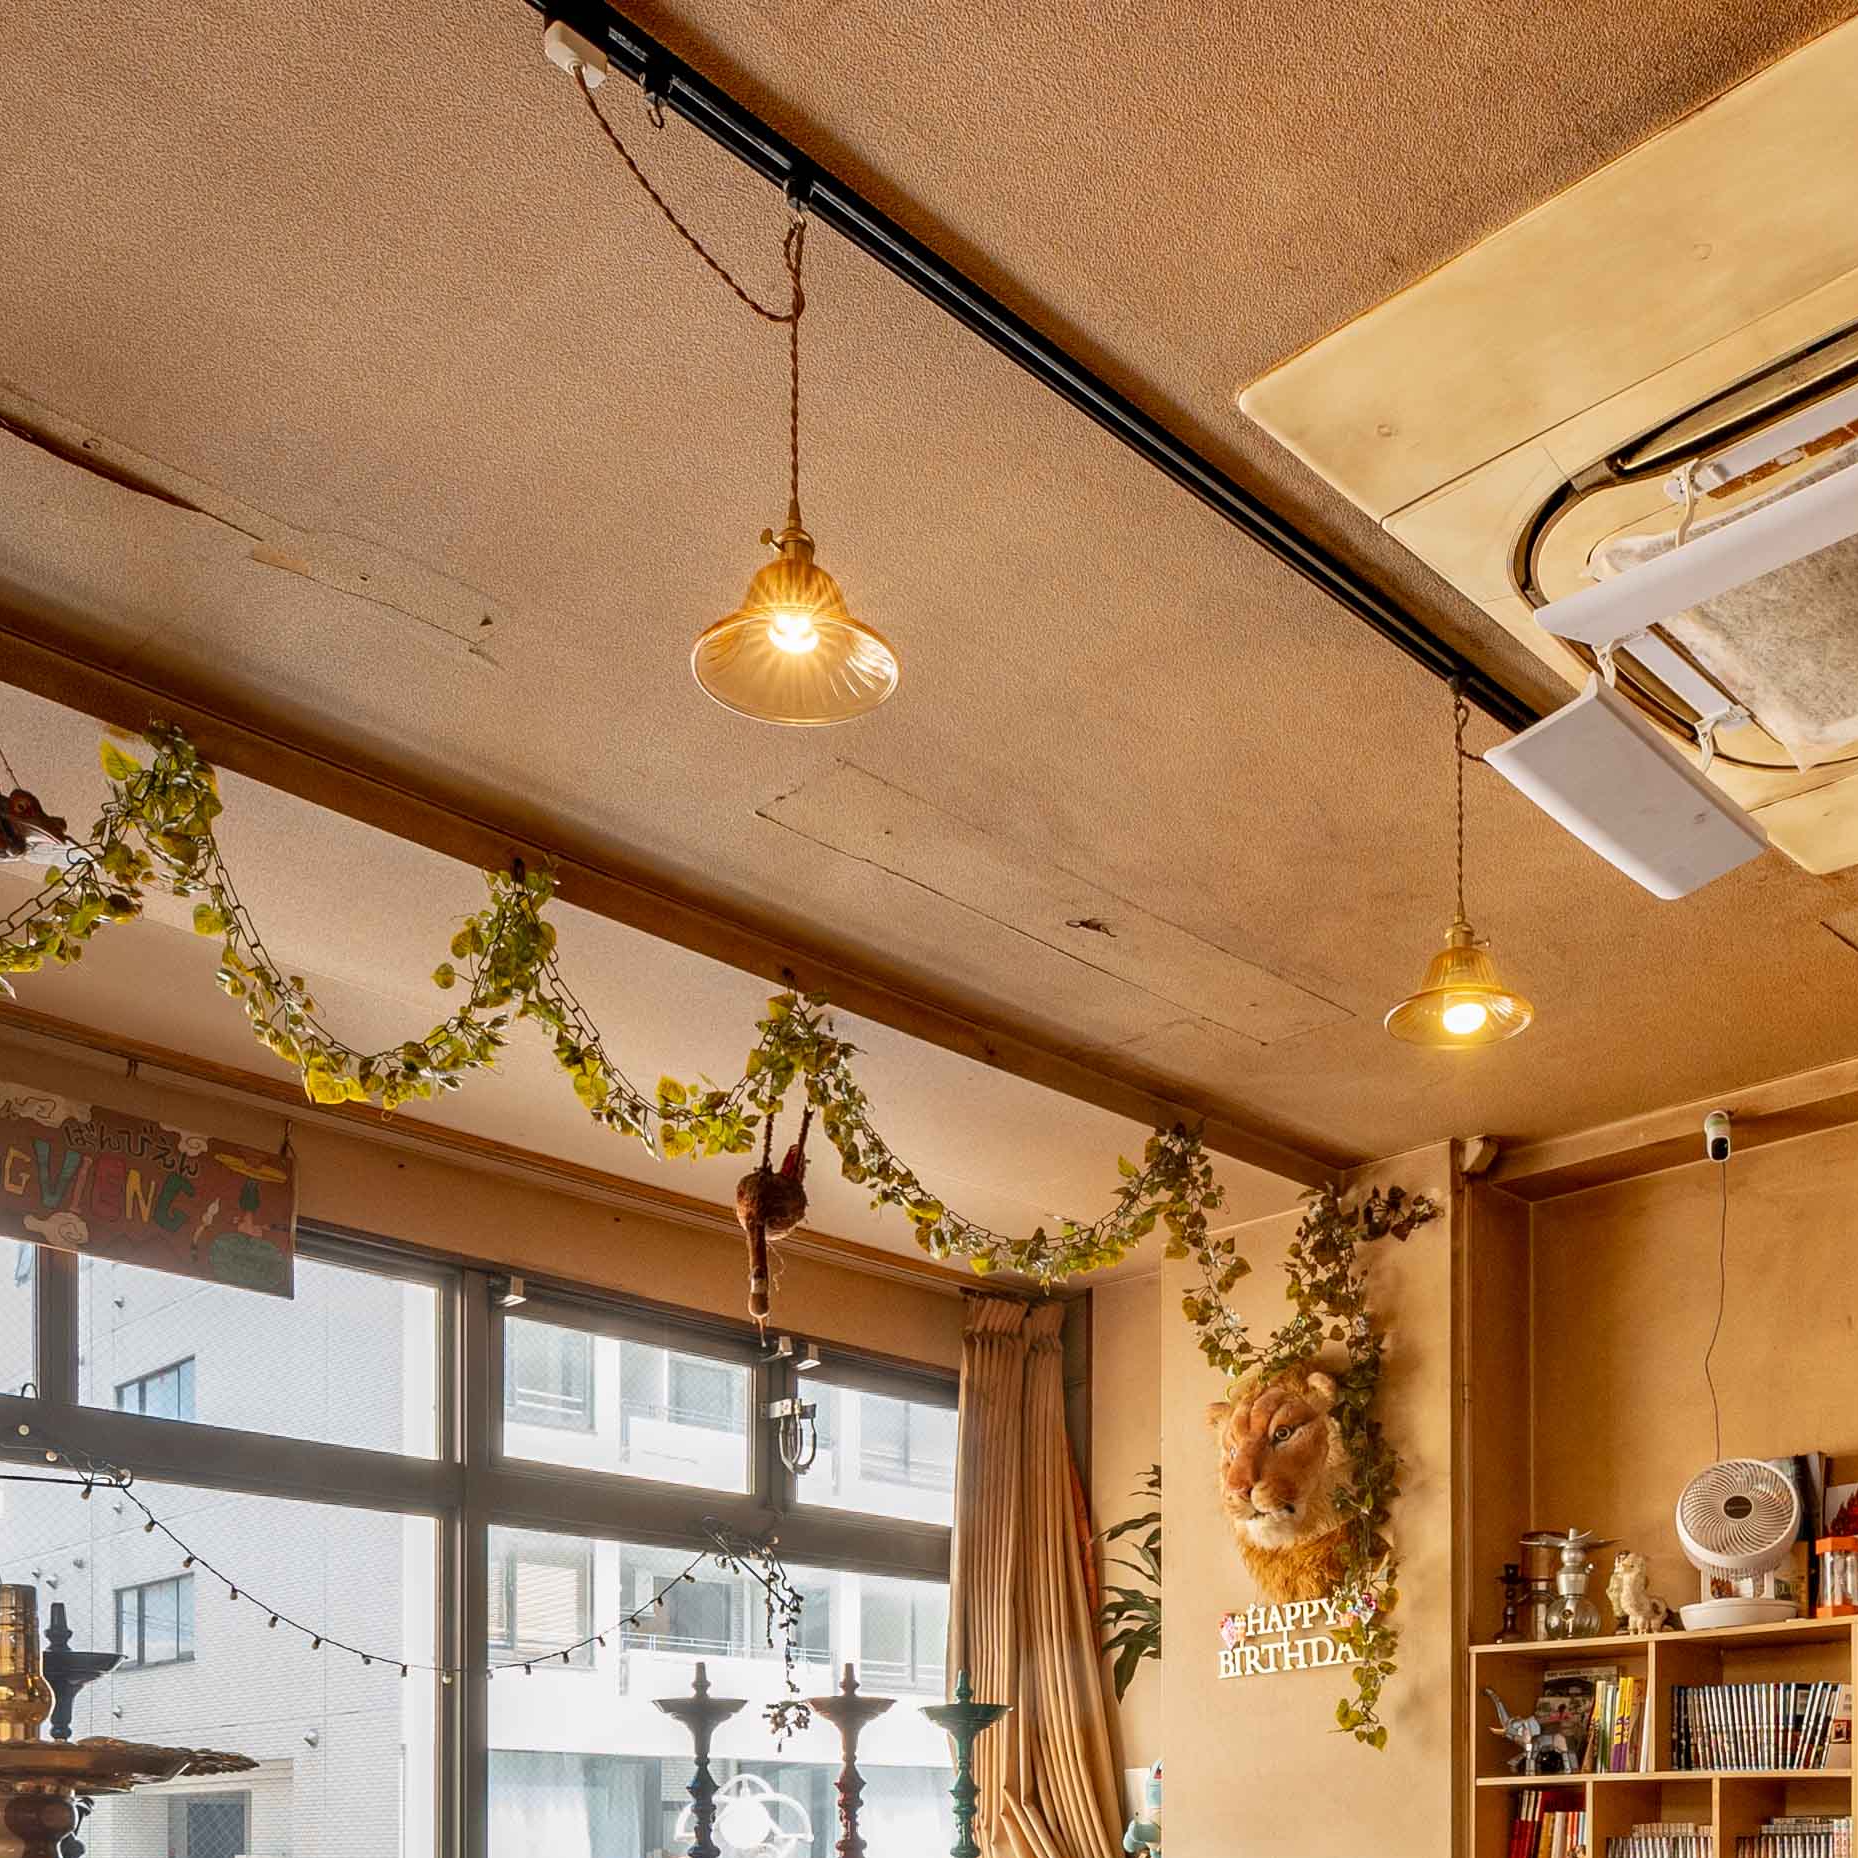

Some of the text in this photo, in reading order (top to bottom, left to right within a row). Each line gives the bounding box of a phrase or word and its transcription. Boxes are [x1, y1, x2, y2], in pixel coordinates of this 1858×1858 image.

[63, 1120, 199, 1176] ばんびえん
[32, 1138, 196, 1233] VIENG
[1246, 1598, 1338, 1637] HAPPY
[1218, 1636, 1360, 1680] BIRTHDA
